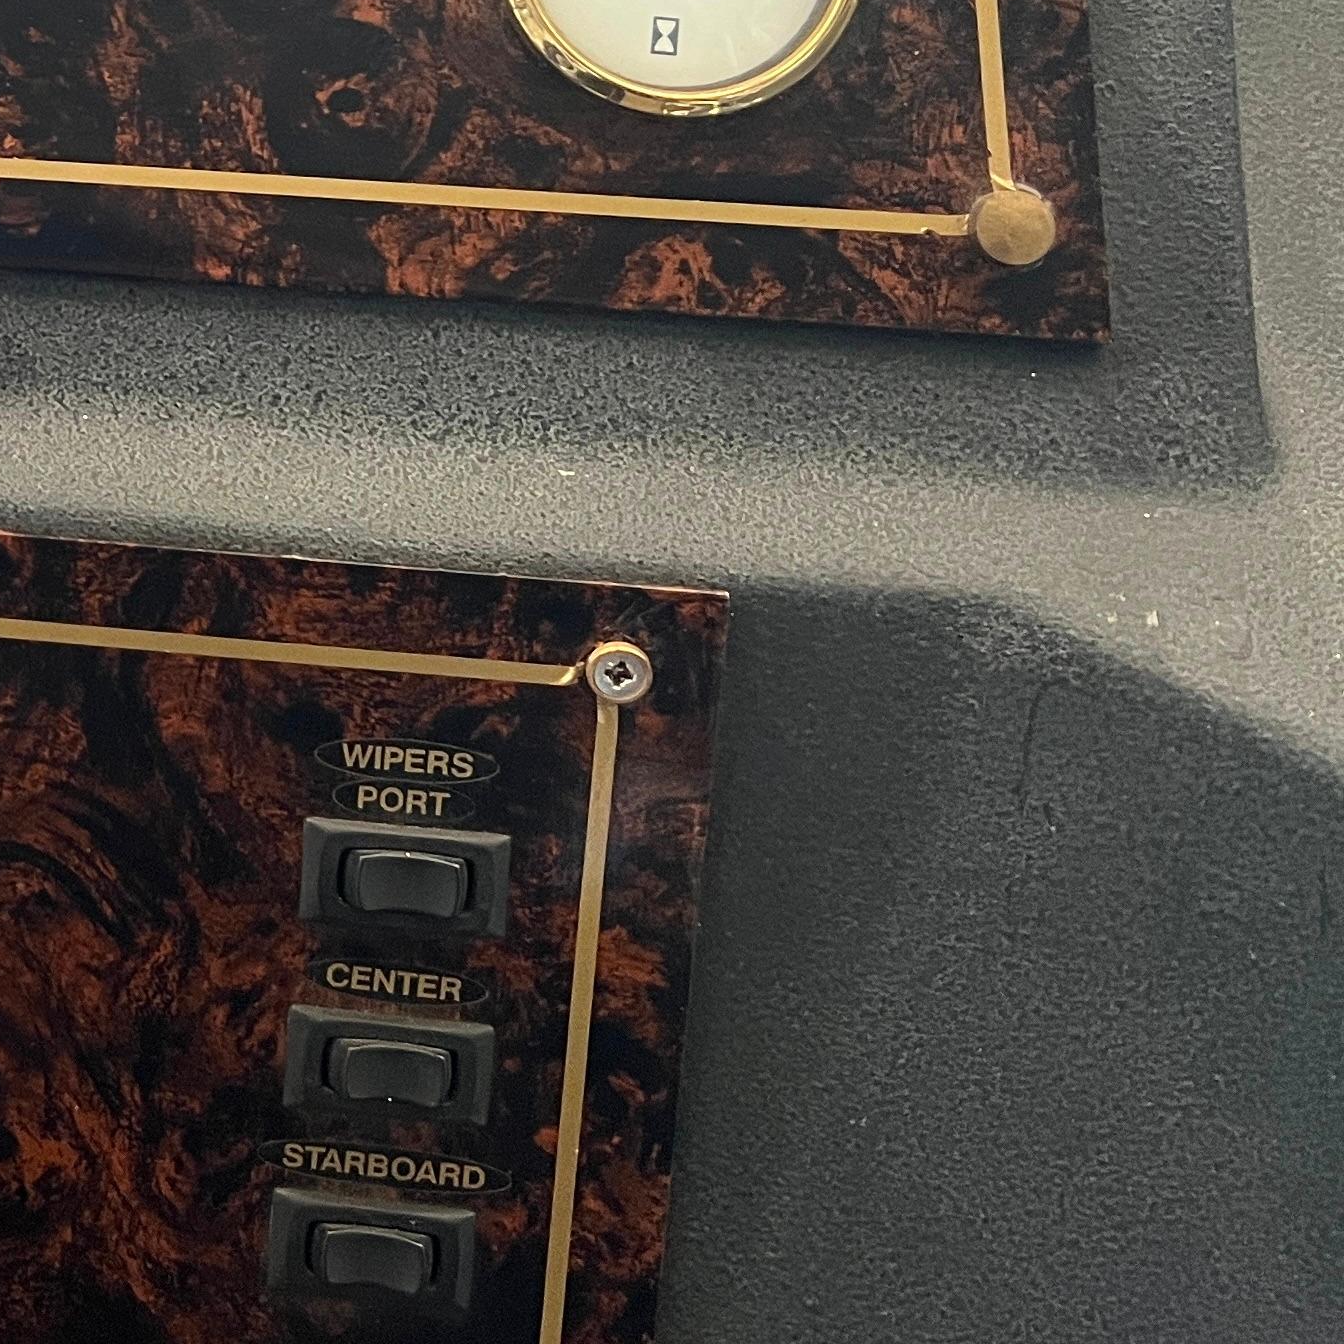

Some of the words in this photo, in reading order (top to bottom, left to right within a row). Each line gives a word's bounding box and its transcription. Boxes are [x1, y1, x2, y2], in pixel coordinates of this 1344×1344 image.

[342, 743, 474, 778] WIPERS
[357, 785, 451, 816] PORT
[326, 962, 462, 1002] CENTER
[282, 1143, 485, 1189] STARBOARD
